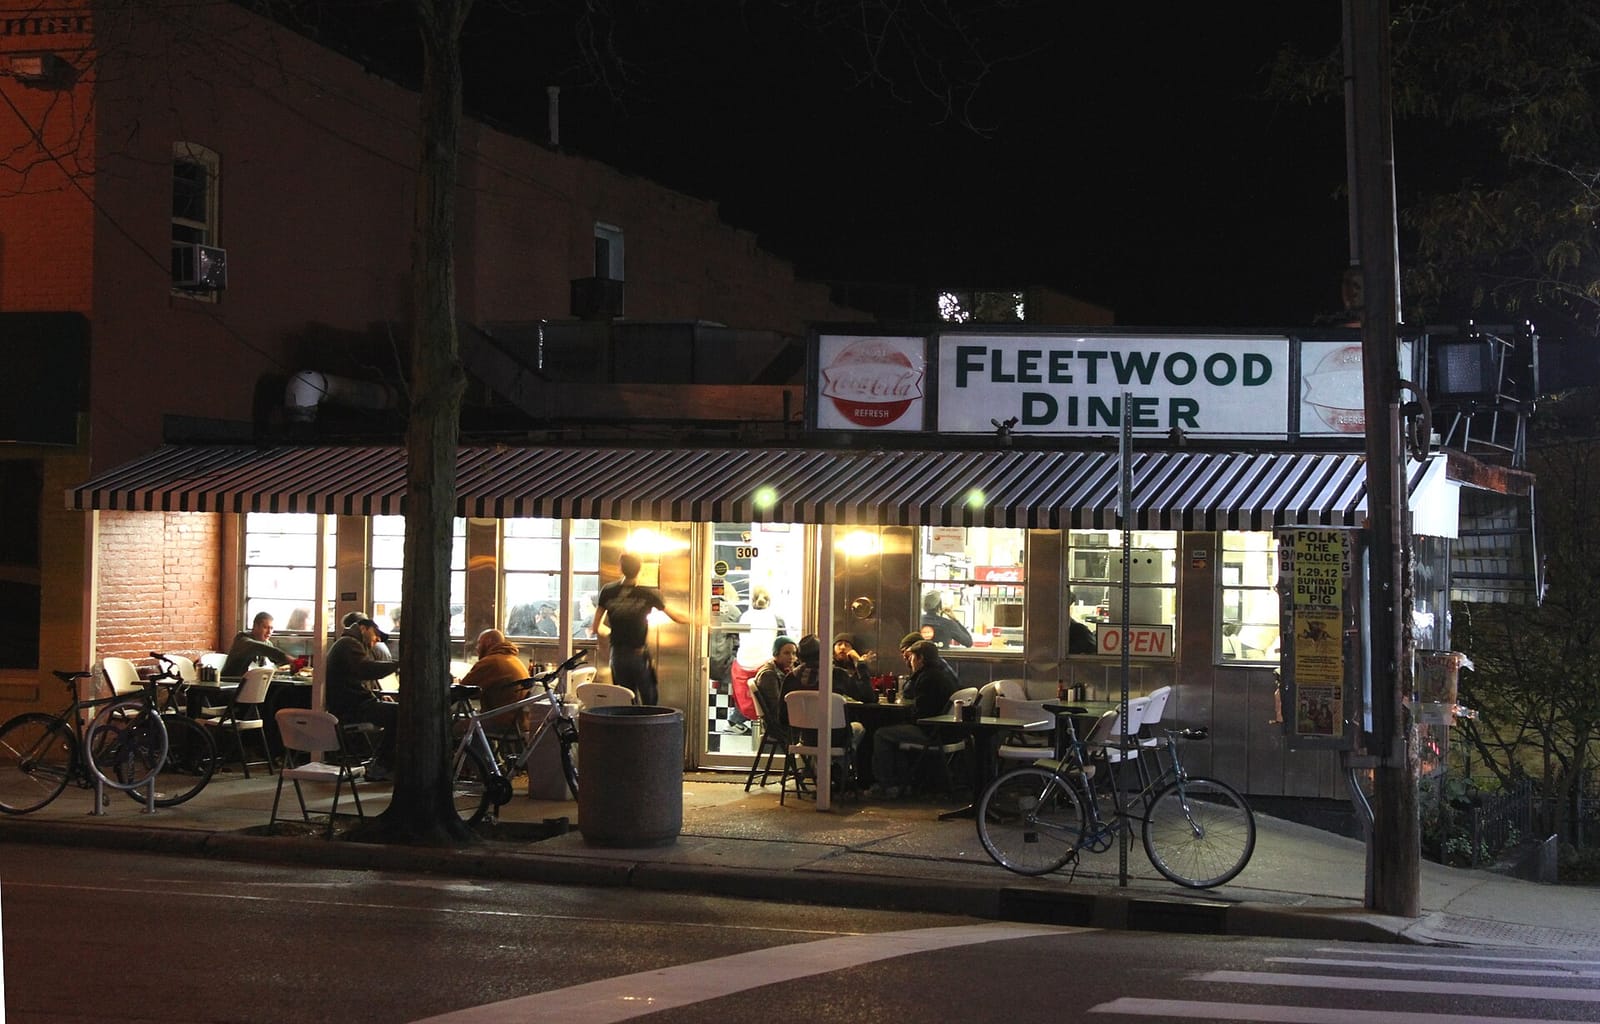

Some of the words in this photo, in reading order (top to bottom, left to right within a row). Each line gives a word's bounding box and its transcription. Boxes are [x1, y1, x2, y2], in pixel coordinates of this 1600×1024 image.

[956, 346, 1273, 388] FLEETWOOD
[854, 408, 889, 418] REFRESH
[1021, 392, 1201, 428] DINER
[1298, 531, 1338, 543] FOLK
[737, 547, 759, 558] 300
[1306, 543, 1329, 552] THE
[1297, 552, 1340, 562] POLICE
[1296, 567, 1338, 578] 1.29.12
[1297, 577, 1337, 585] SUNDAY
[1297, 585, 1336, 595] BLIND
[1309, 594, 1331, 604] PIG
